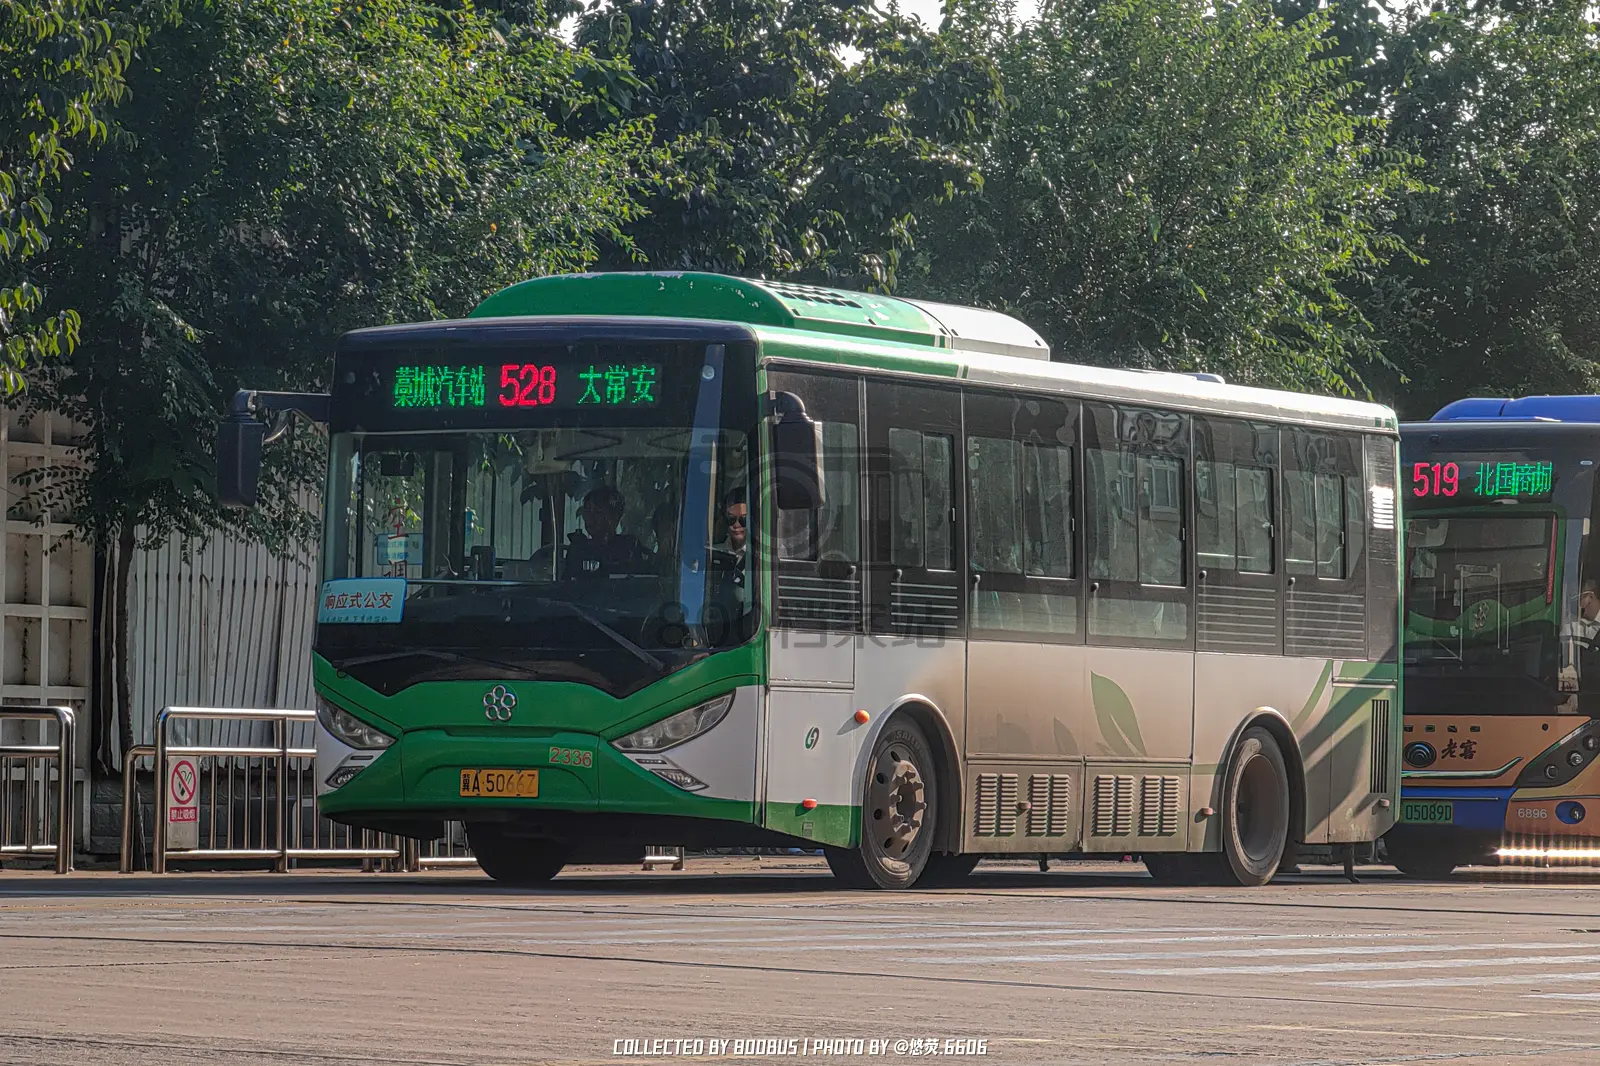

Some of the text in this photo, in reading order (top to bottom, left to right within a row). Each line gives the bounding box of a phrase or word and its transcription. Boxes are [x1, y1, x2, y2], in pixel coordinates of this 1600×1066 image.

[499, 364, 556, 406] 528
[578, 364, 656, 405] 大常安
[1413, 461, 1552, 497] 519 北国商城
[325, 592, 393, 610] 响应式公交
[550, 748, 592, 766] 2336
[1441, 738, 1477, 760] 老窖
[1405, 804, 1452, 822] 05089D
[1518, 808, 1548, 819] 6896
